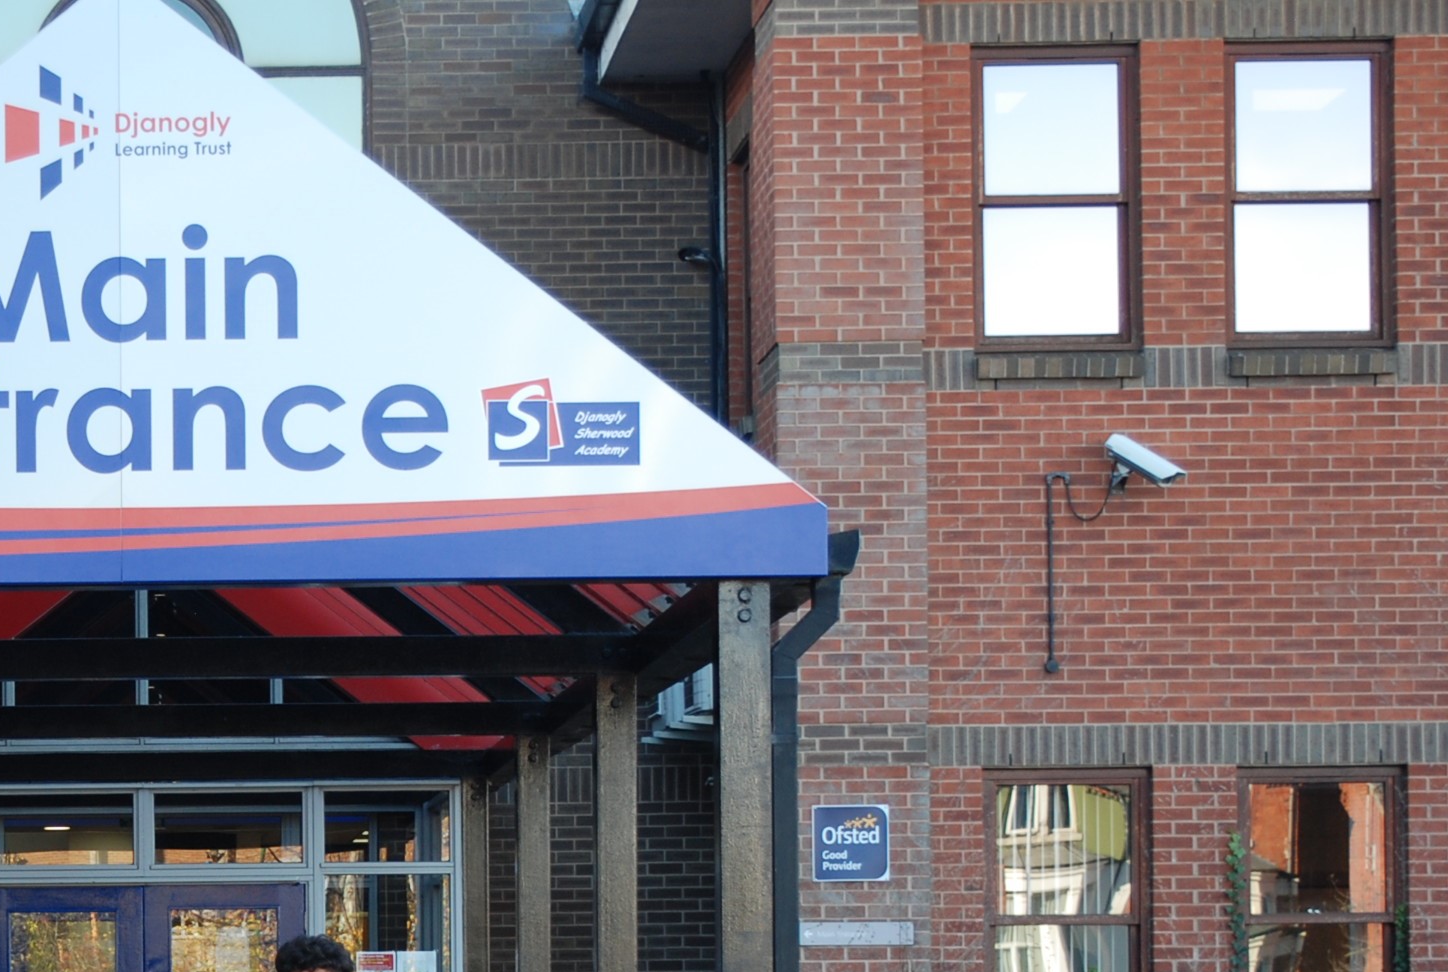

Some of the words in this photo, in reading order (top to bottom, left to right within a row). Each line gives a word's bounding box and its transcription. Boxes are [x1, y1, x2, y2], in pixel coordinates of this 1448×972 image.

[114, 111, 231, 138] Djanogly
[114, 142, 189, 159] Learning
[193, 141, 232, 155] Trust
[574, 411, 628, 426] Djanogly
[574, 427, 635, 439] Sherwood
[574, 444, 630, 458] Academy
[821, 825, 880, 845] Ofsted
[821, 850, 848, 860] Good
[822, 861, 862, 871] Provider
